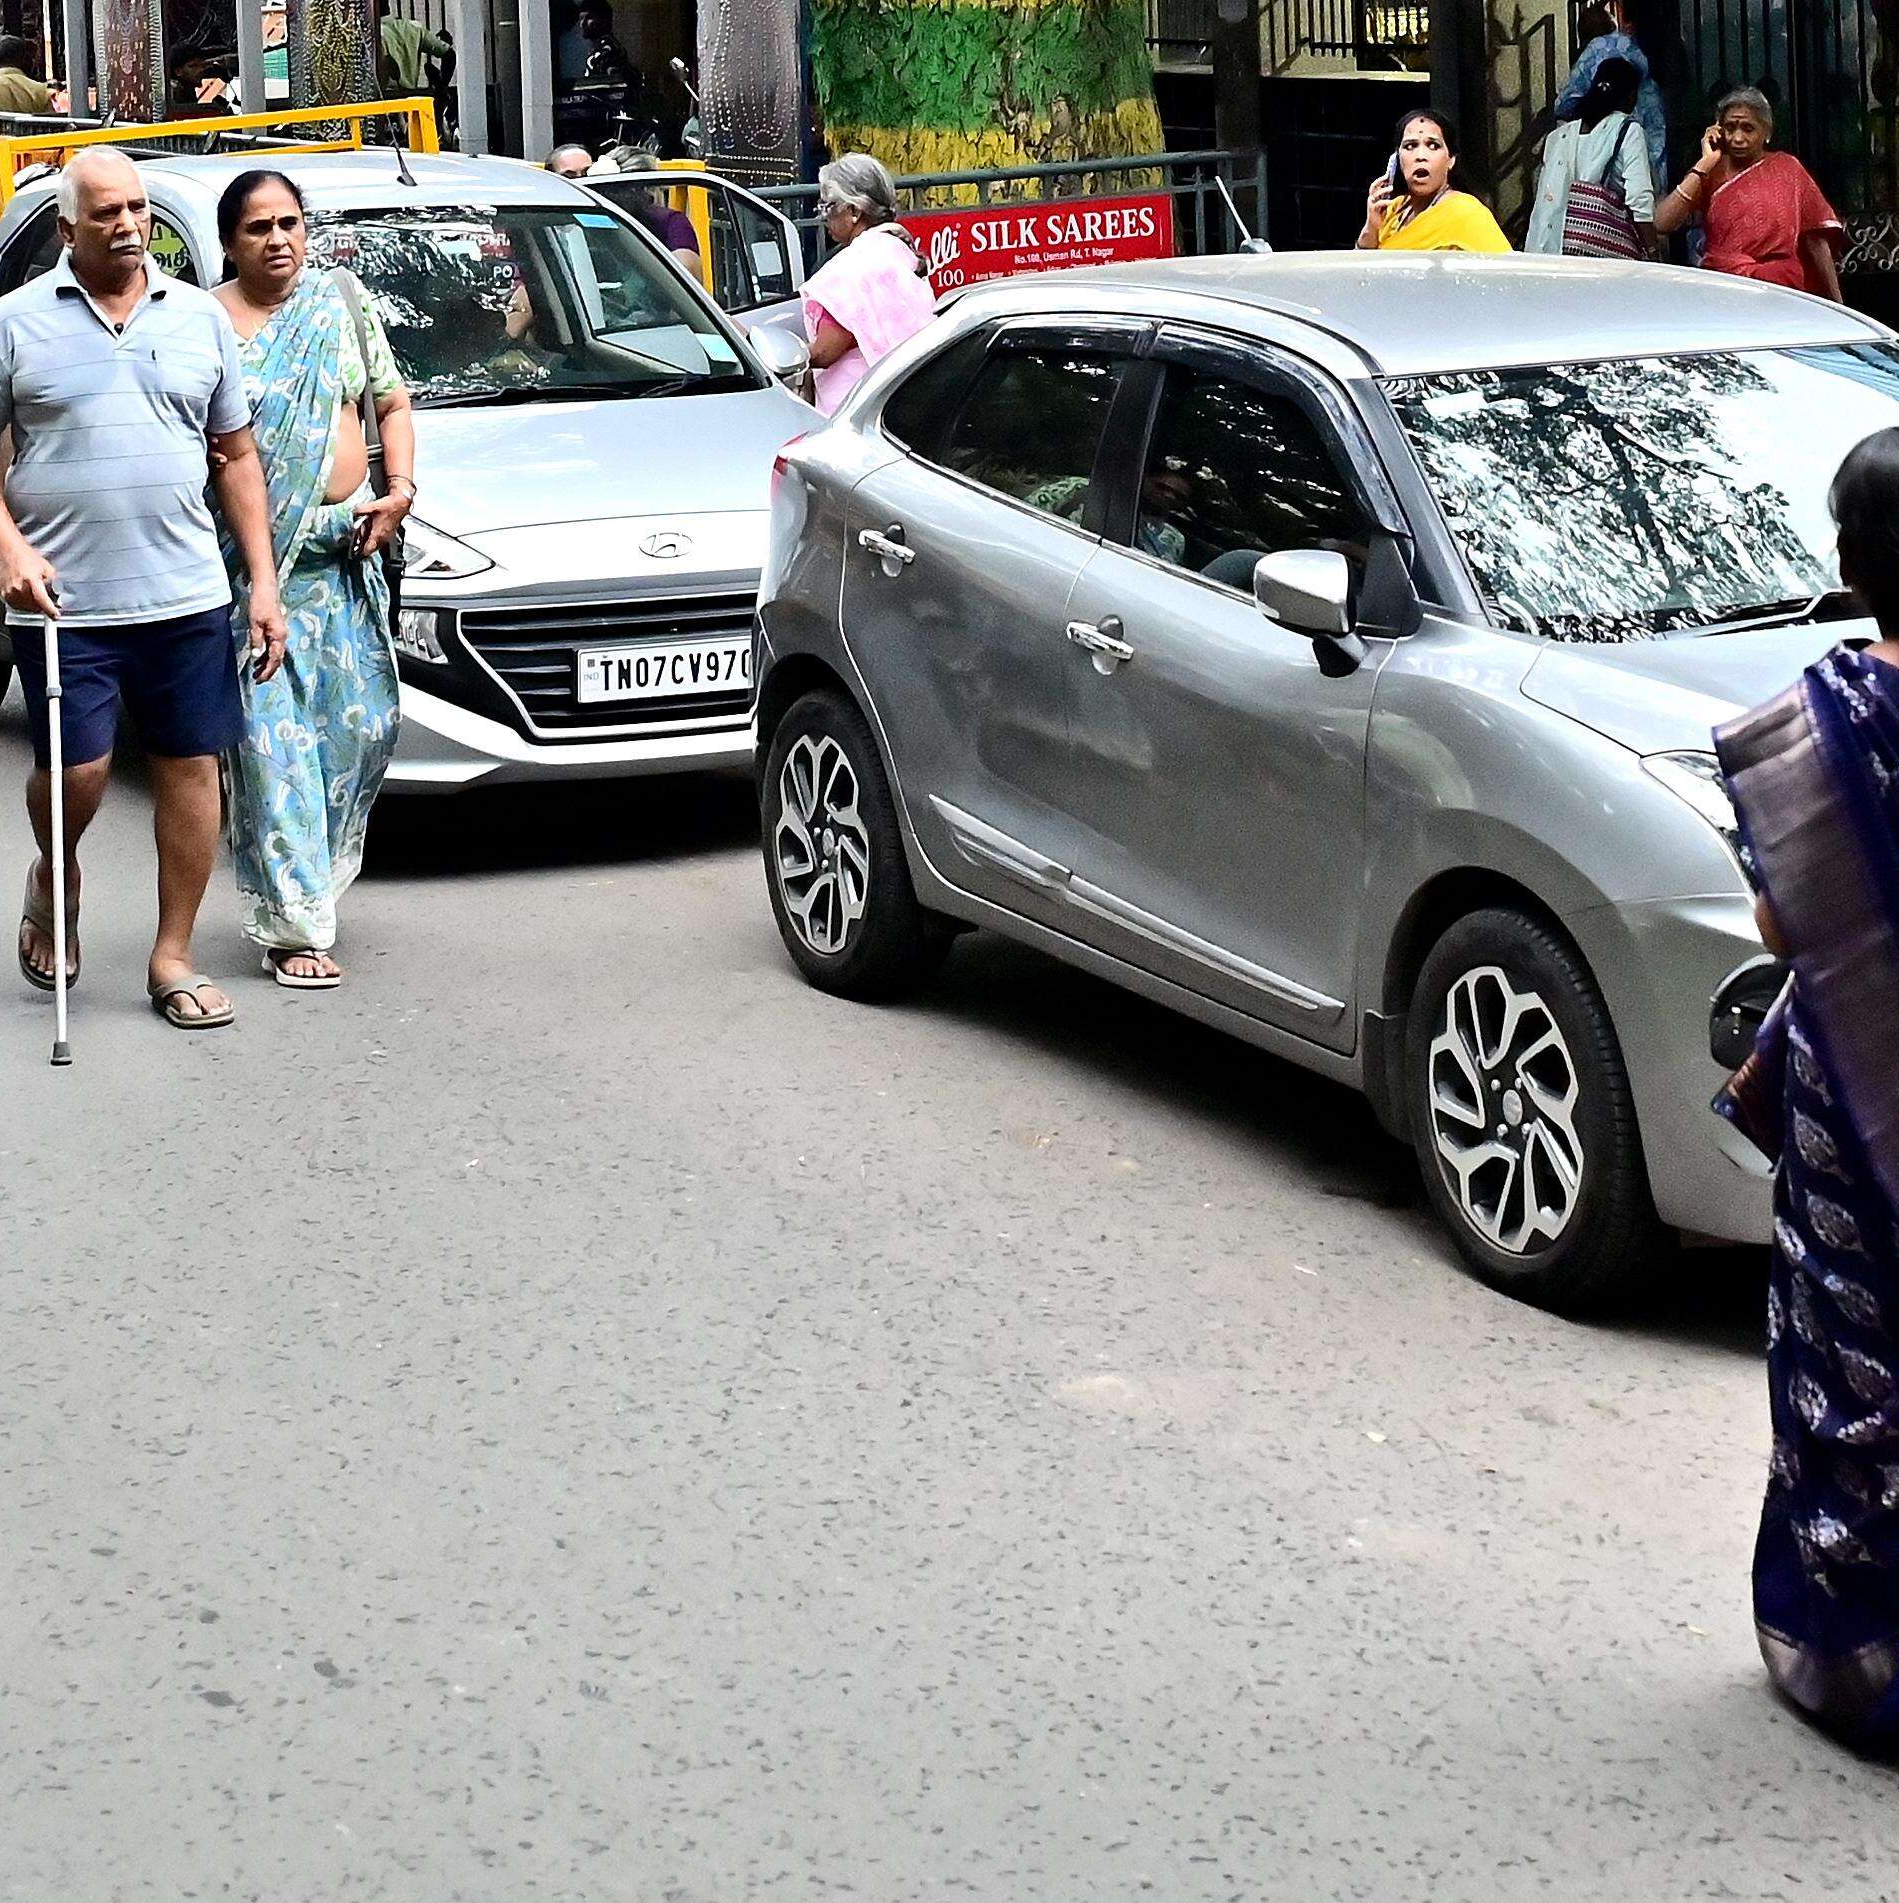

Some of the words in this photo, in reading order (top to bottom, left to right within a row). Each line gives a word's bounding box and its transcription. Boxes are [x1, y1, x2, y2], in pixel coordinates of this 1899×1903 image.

[970, 216, 1040, 254] SILK
[1047, 206, 1156, 246] SAREES
[1092, 247, 1115, 258] Nagar
[936, 268, 965, 288] 100
